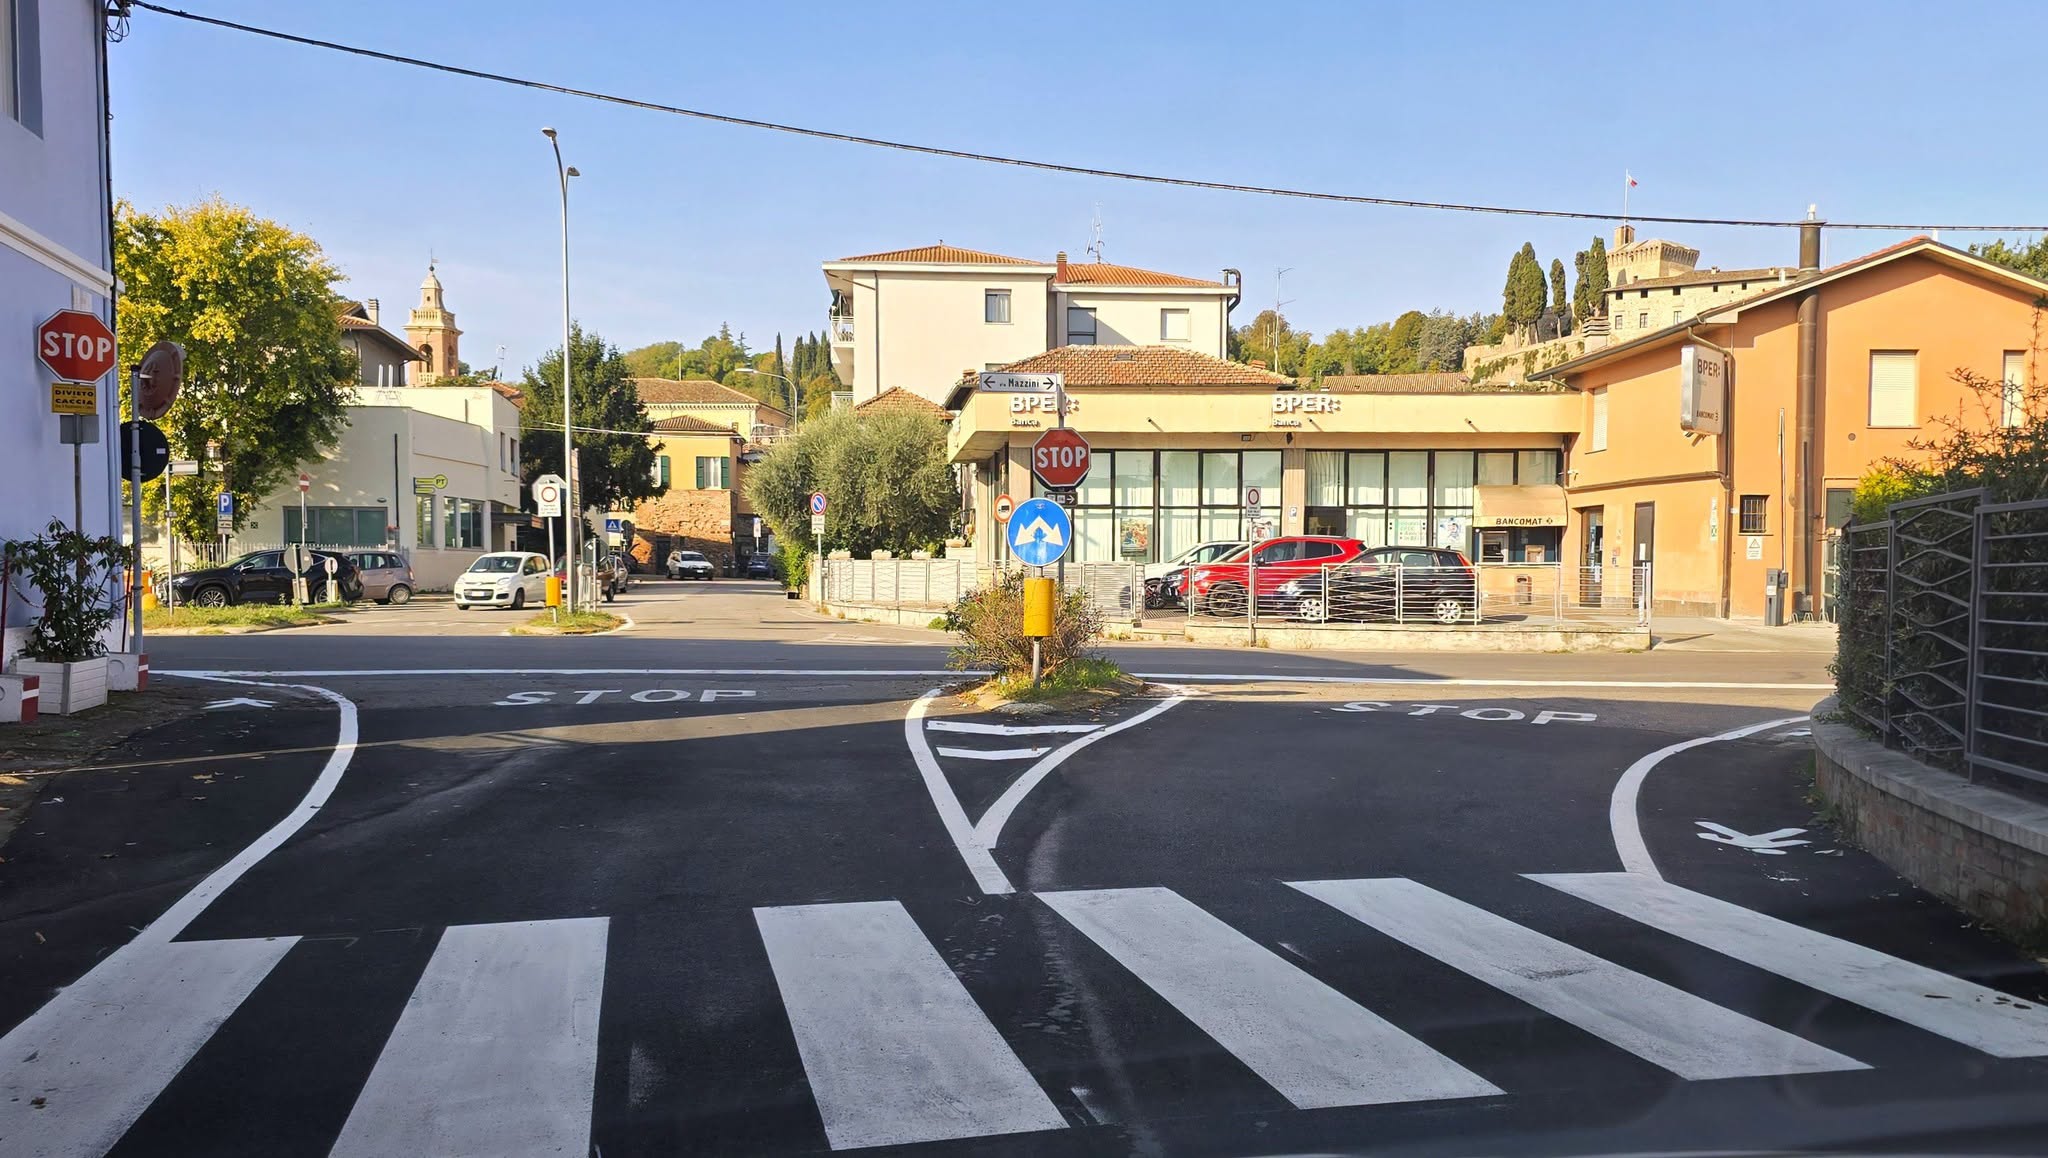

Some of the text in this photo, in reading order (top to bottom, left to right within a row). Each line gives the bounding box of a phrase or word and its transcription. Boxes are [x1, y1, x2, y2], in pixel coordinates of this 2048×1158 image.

[43, 331, 112, 362] STOP
[1697, 359, 1721, 377] BPER:
[1008, 378, 1040, 389] Mazzini
[55, 389, 94, 397] DIVIETO
[1273, 394, 1341, 414] BPER:
[1037, 446, 1087, 468] STOP
[220, 494, 230, 512] P
[1495, 517, 1543, 526] BANCOMAT
[493, 689, 757, 706] STOP
[1331, 701, 1598, 725] STOP
